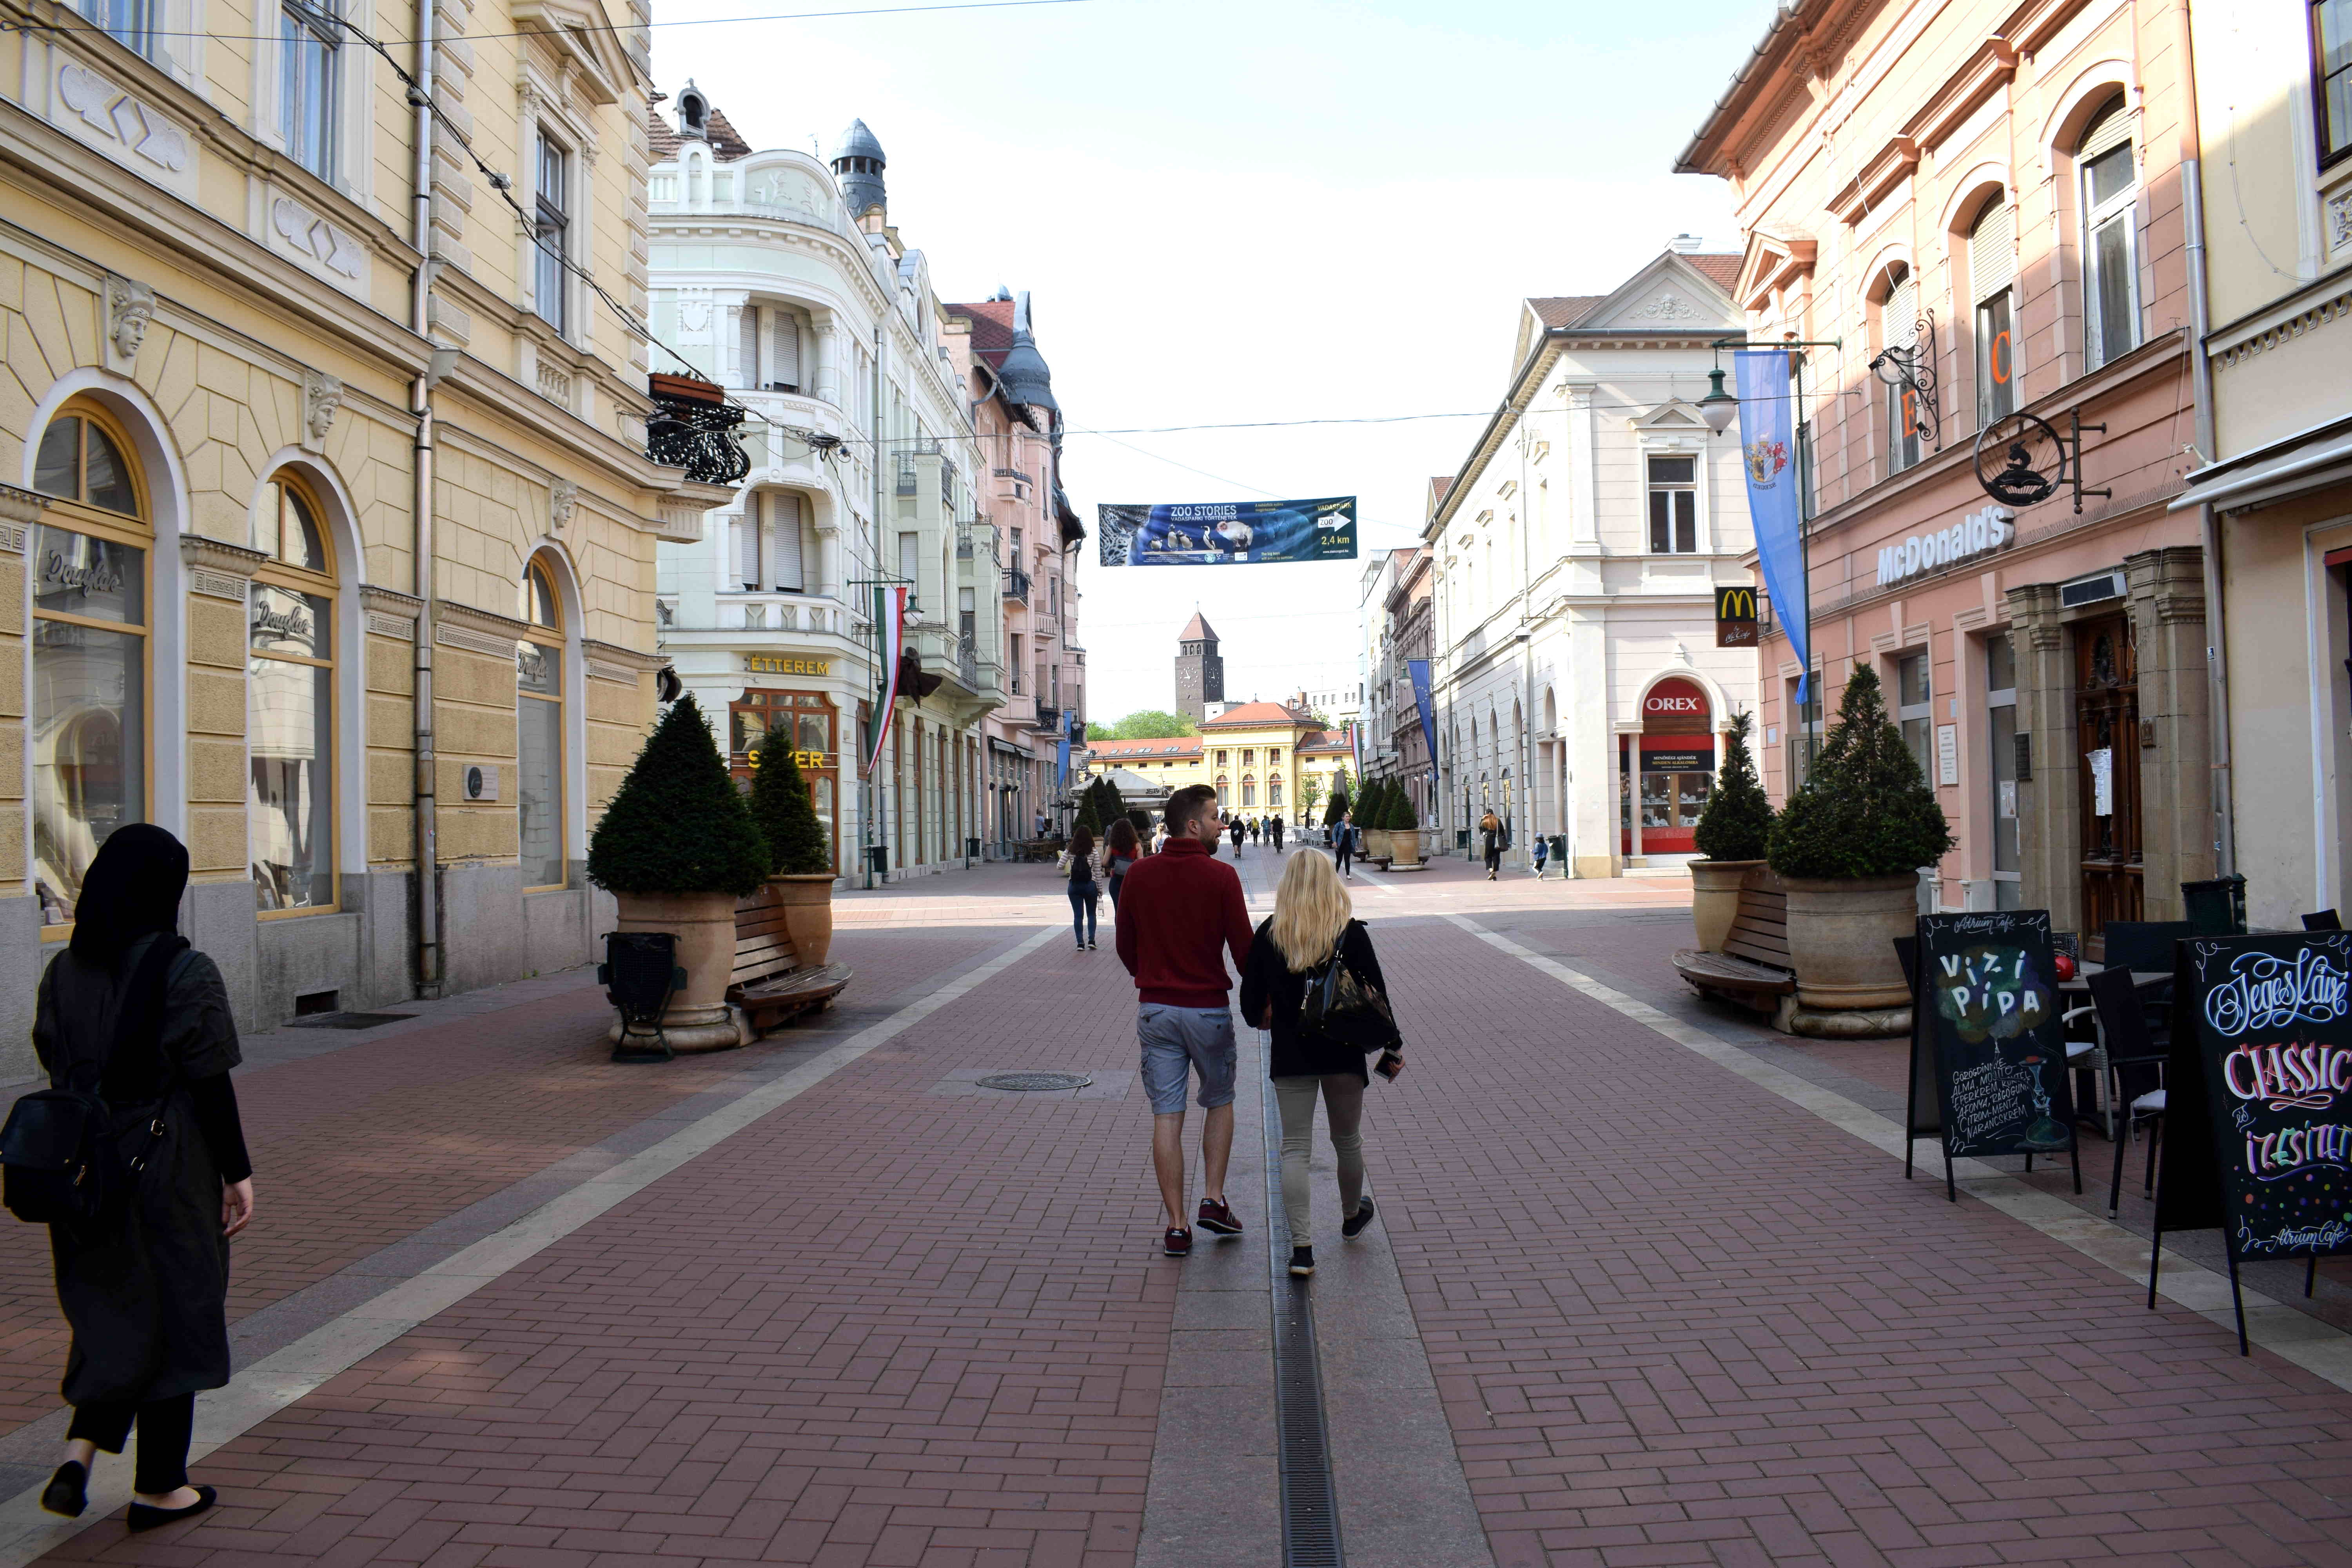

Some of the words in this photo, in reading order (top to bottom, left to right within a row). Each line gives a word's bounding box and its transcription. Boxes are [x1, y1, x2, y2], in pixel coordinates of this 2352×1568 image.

[1171, 506, 1192, 517] ZOO
[1194, 505, 1237, 516] STORIES
[1318, 502, 1352, 511] VADASPARK
[1321, 535, 1335, 546] 2,4
[1337, 536, 1349, 544] km
[1877, 505, 2013, 586] McDonald's
[46, 549, 120, 598] Douglas
[257, 601, 309, 639] Douglas
[751, 655, 829, 675] ÉTTEREM
[1646, 698, 1698, 710] OREX
[2224, 1041, 2352, 1101] CLASSIC
